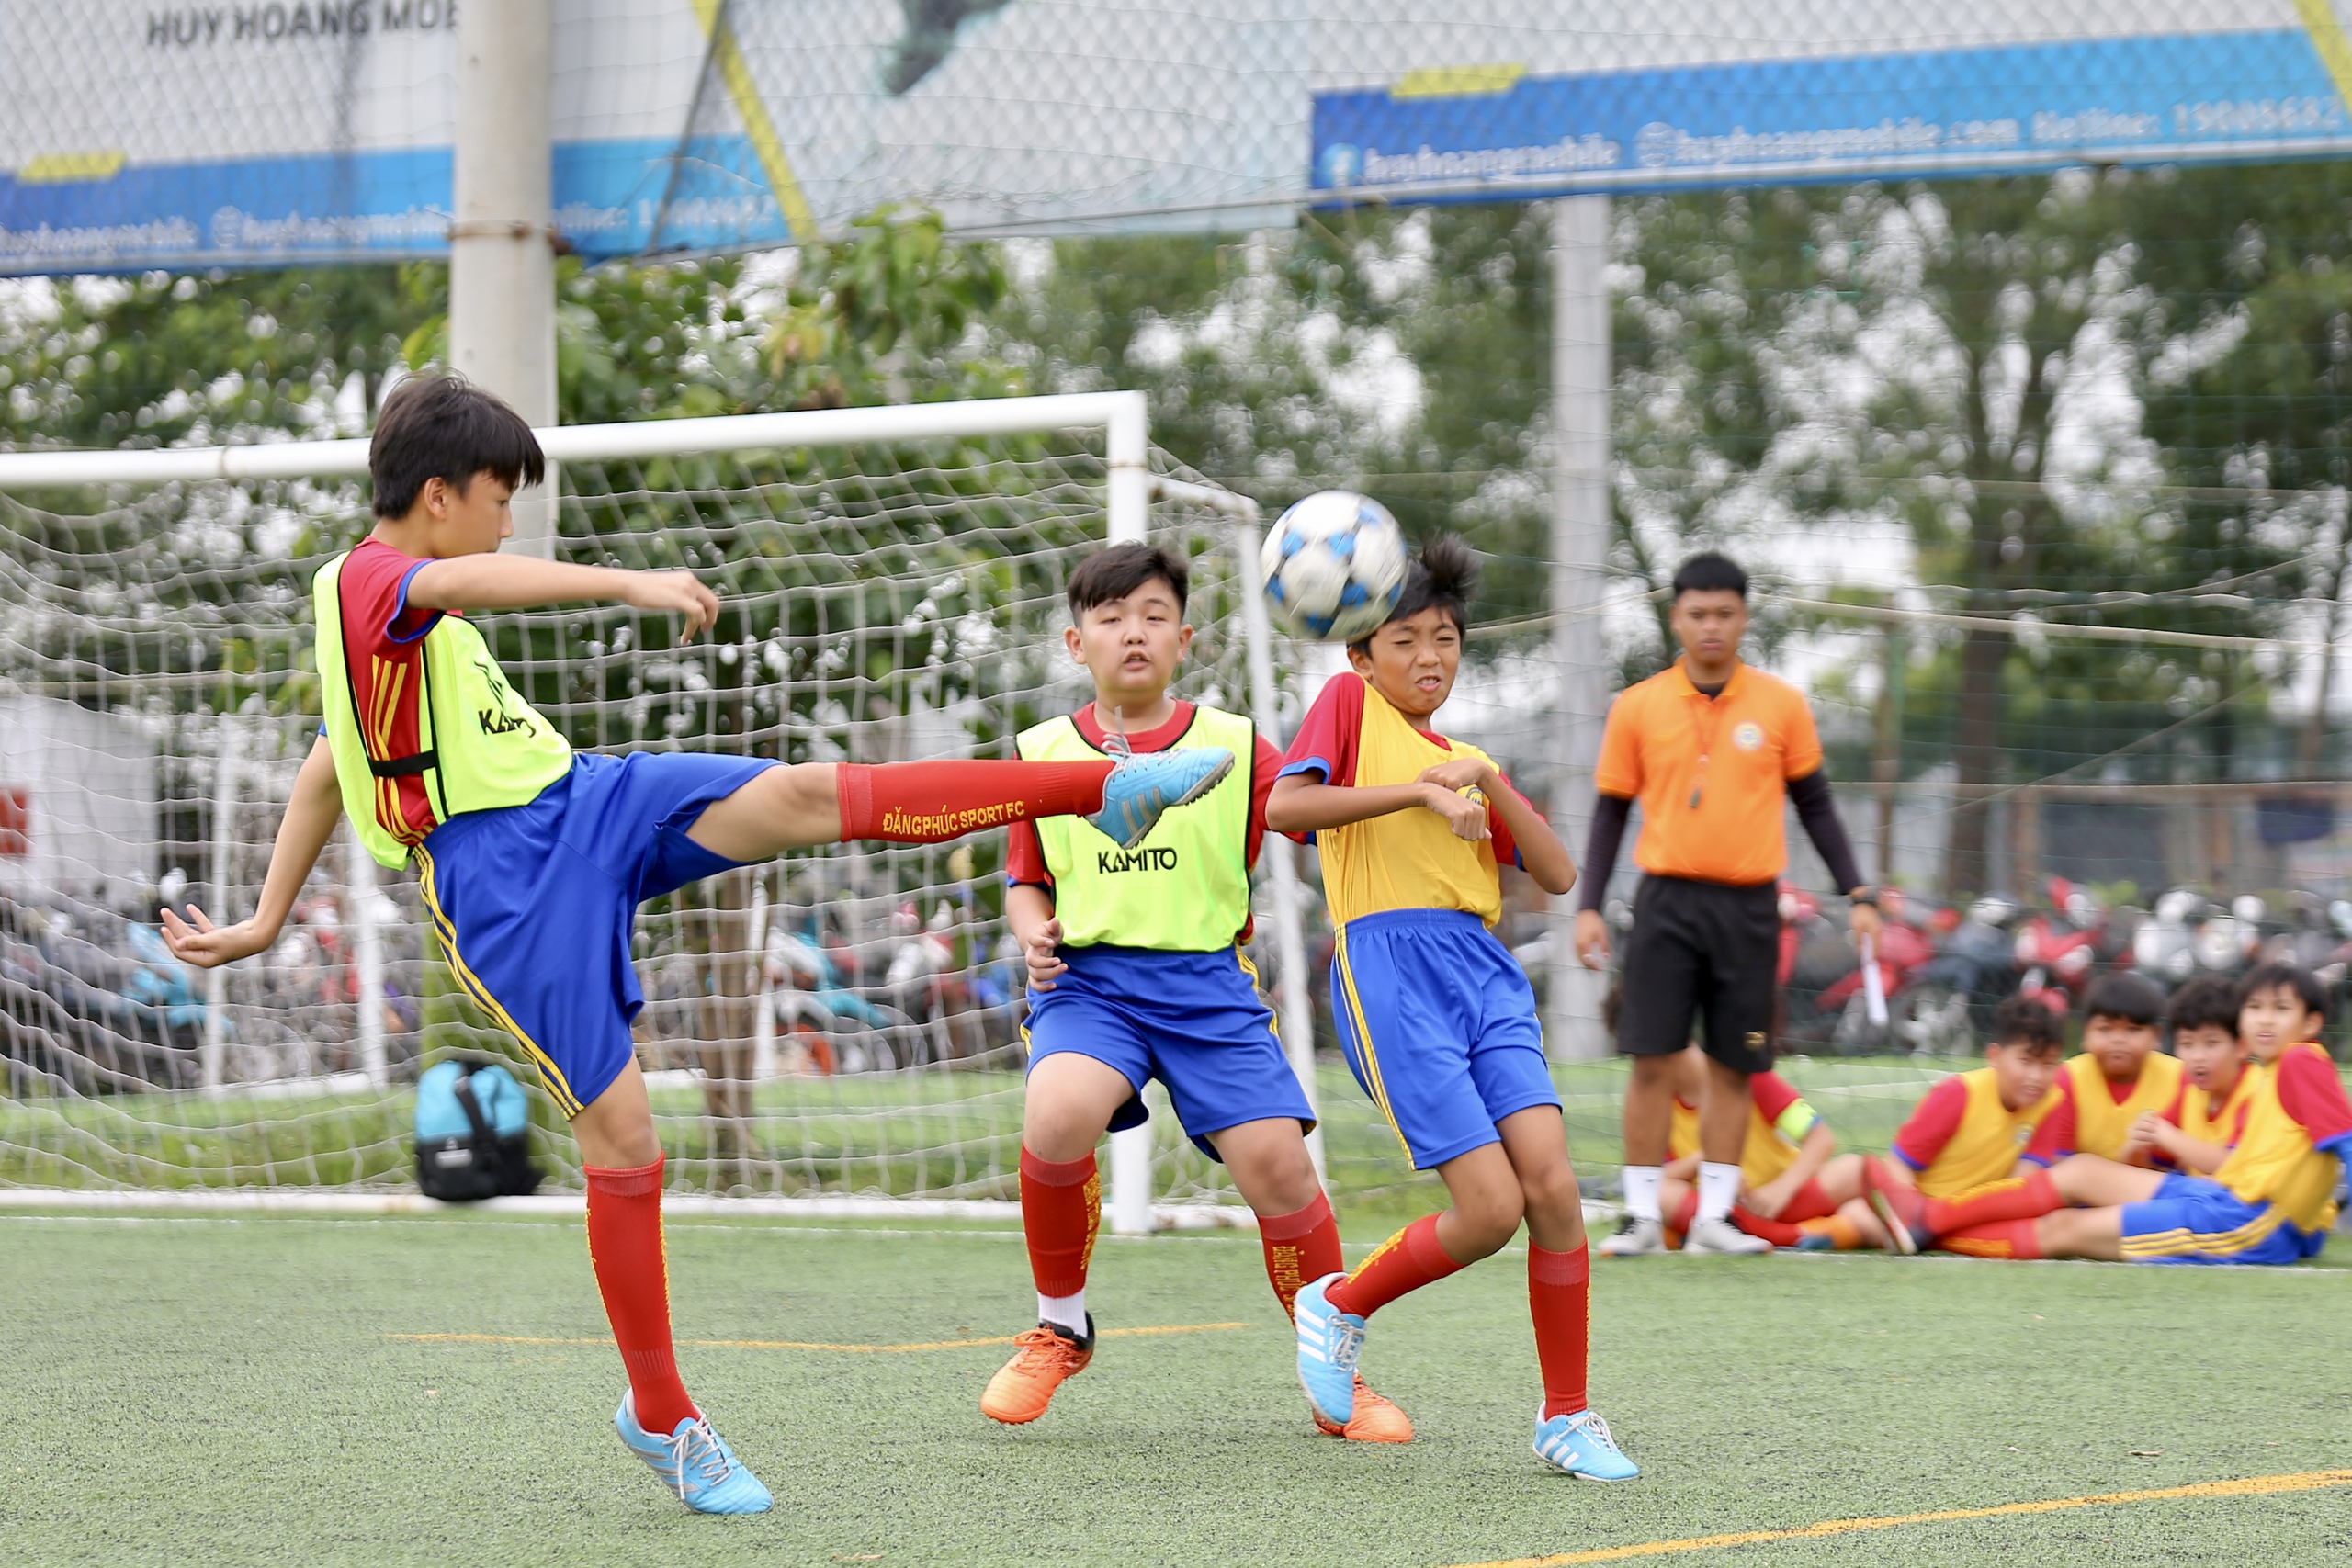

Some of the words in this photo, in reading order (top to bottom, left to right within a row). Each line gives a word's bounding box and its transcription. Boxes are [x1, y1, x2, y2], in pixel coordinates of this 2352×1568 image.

[147, 8, 220, 45] HUY
[233, 2, 370, 39] HOANG
[959, 803, 1003, 829] SPORT
[1005, 800, 1025, 818] FC
[1098, 847, 1178, 874] KAMITO
